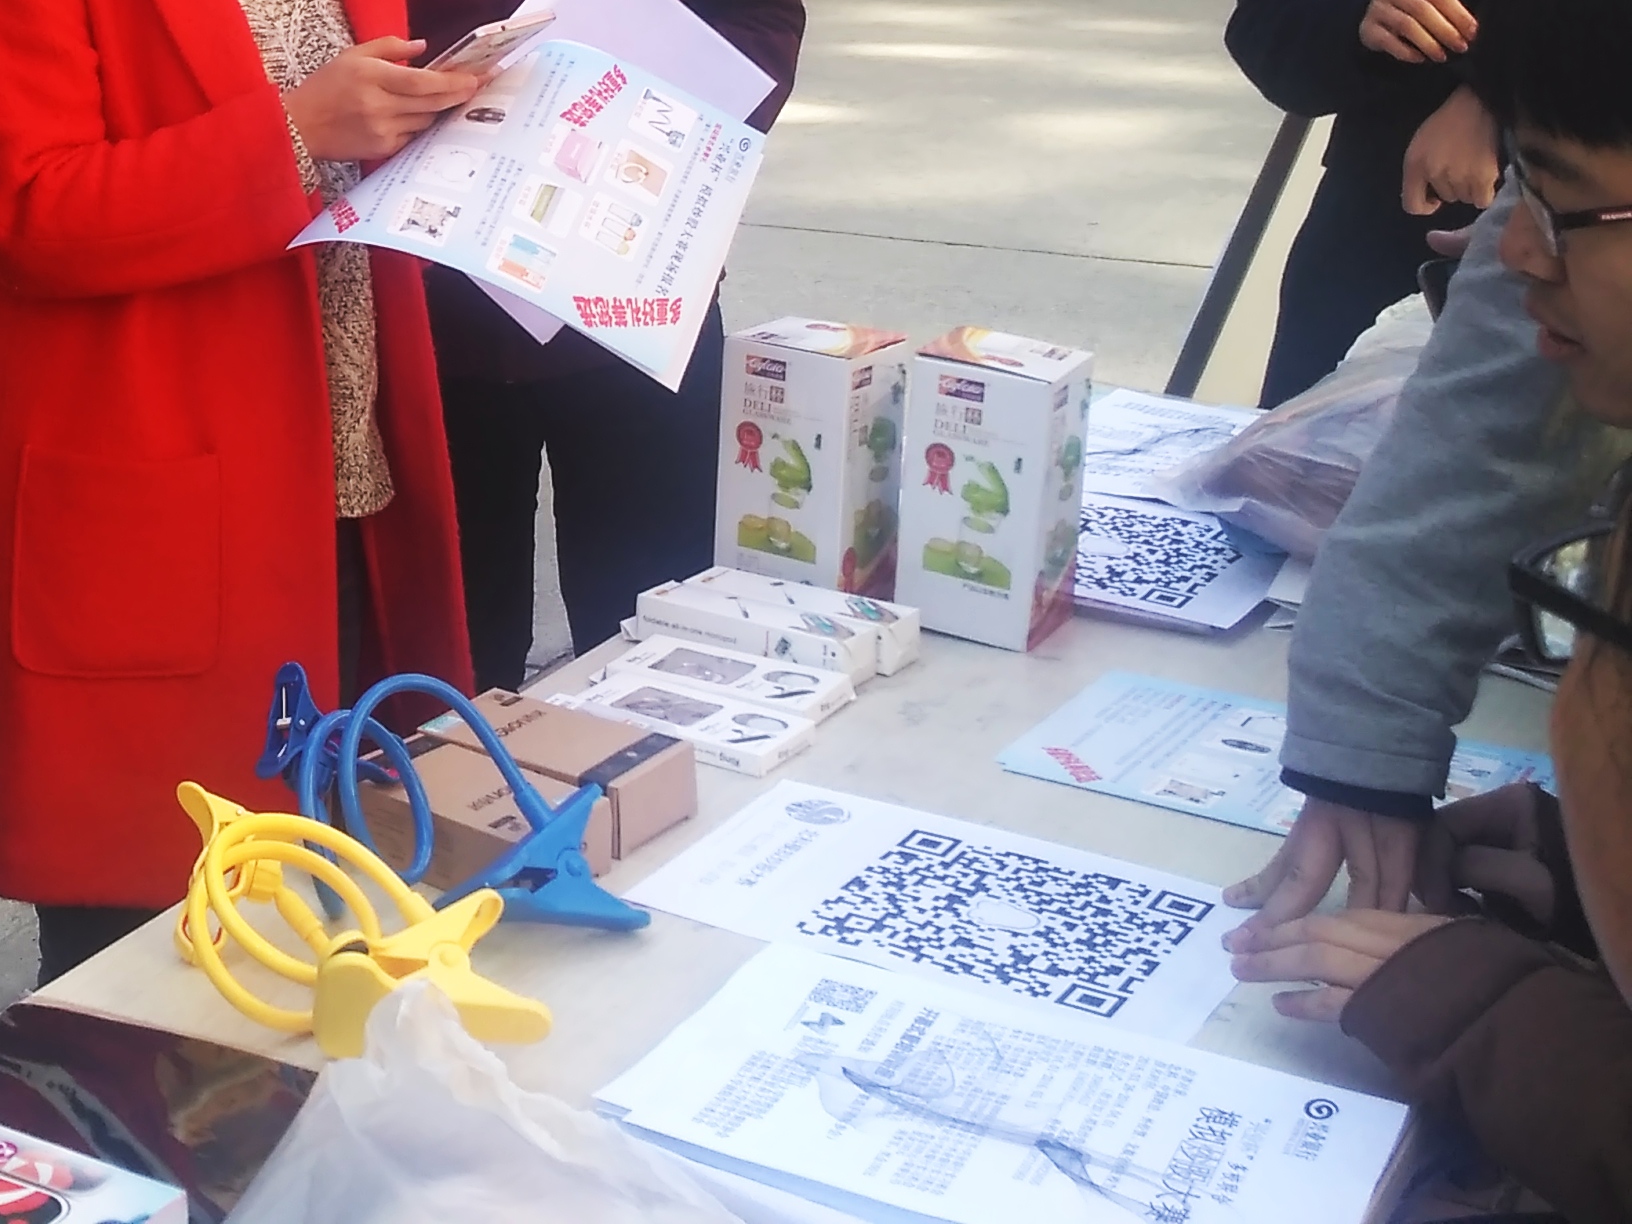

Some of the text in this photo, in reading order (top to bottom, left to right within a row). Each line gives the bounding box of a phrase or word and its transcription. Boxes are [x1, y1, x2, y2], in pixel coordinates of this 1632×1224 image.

[559, 63, 628, 128] 多重好礼等您选
[572, 296, 682, 328] 多重好礼等您选
[1145, 1106, 1243, 1224] 模拟炒股大赛
